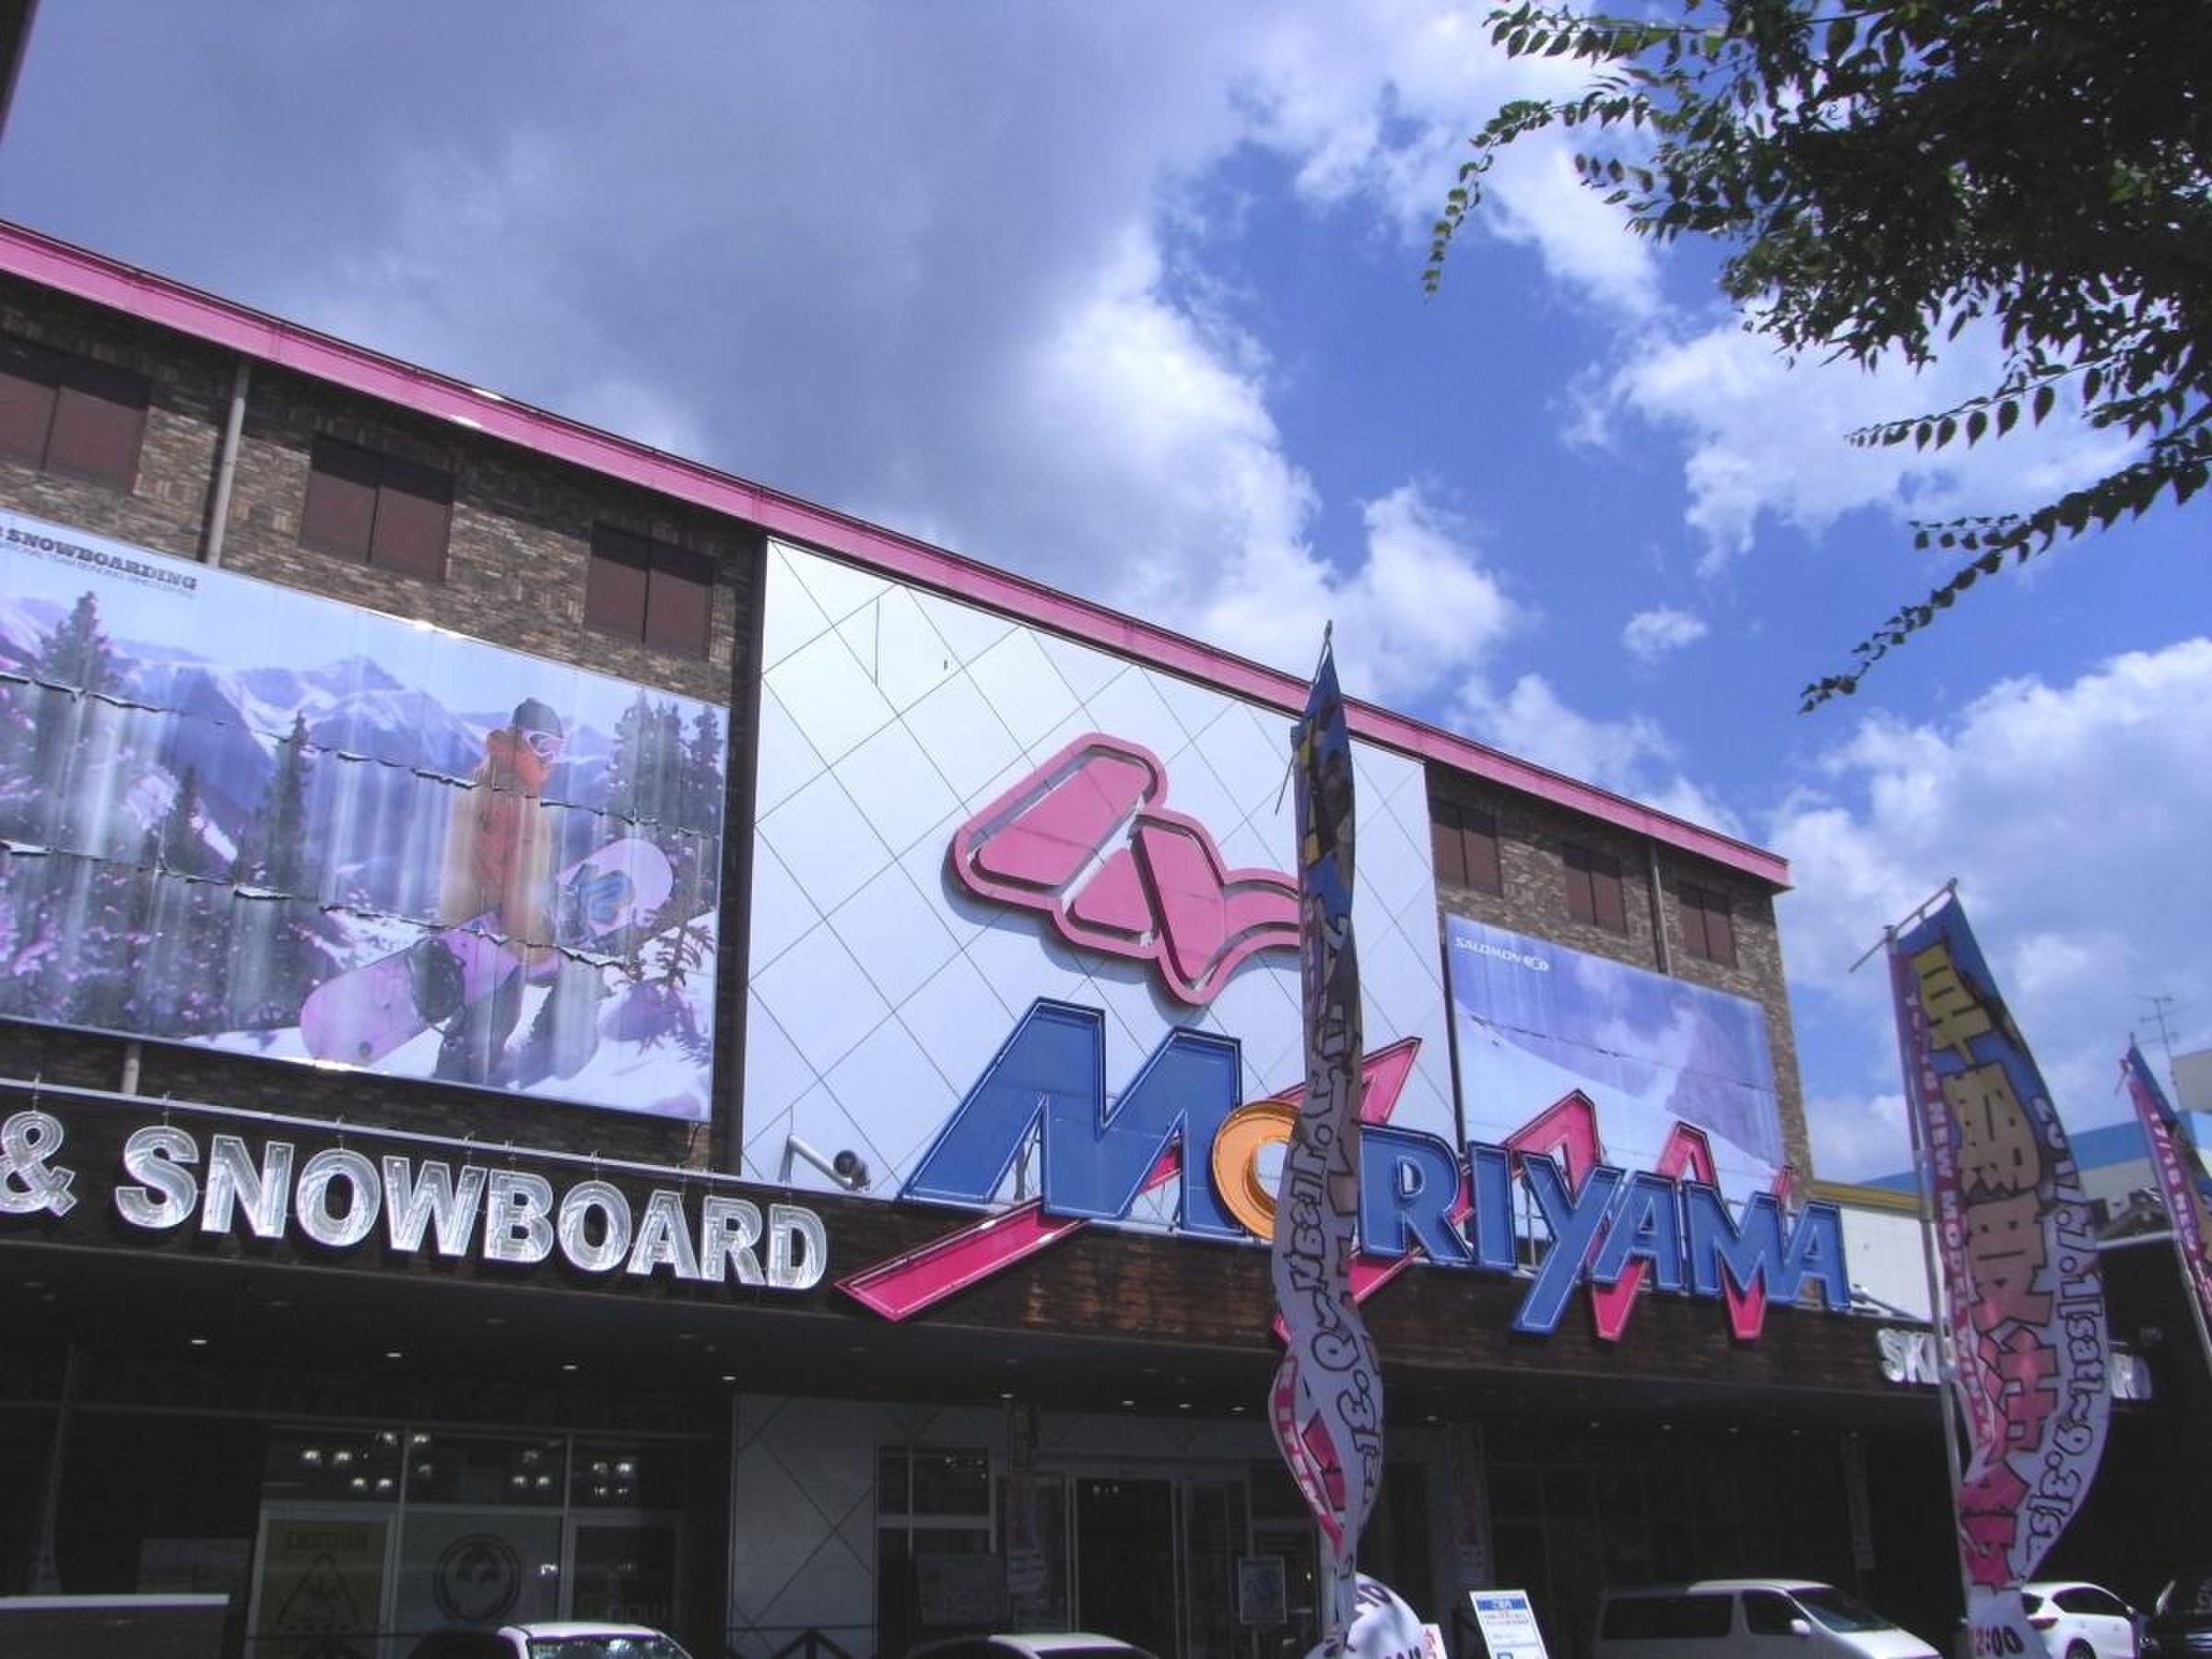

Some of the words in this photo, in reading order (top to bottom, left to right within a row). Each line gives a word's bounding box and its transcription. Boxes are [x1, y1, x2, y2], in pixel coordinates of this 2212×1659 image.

[6, 527, 197, 591] SNOWBOARDING
[1455, 936, 1520, 963] SALOMON
[896, 996, 1851, 1335] MORIYAMA
[1928, 1101, 1955, 1182] NEW
[0, 1111, 77, 1218] &
[115, 1124, 829, 1290] SNOWBOARD
